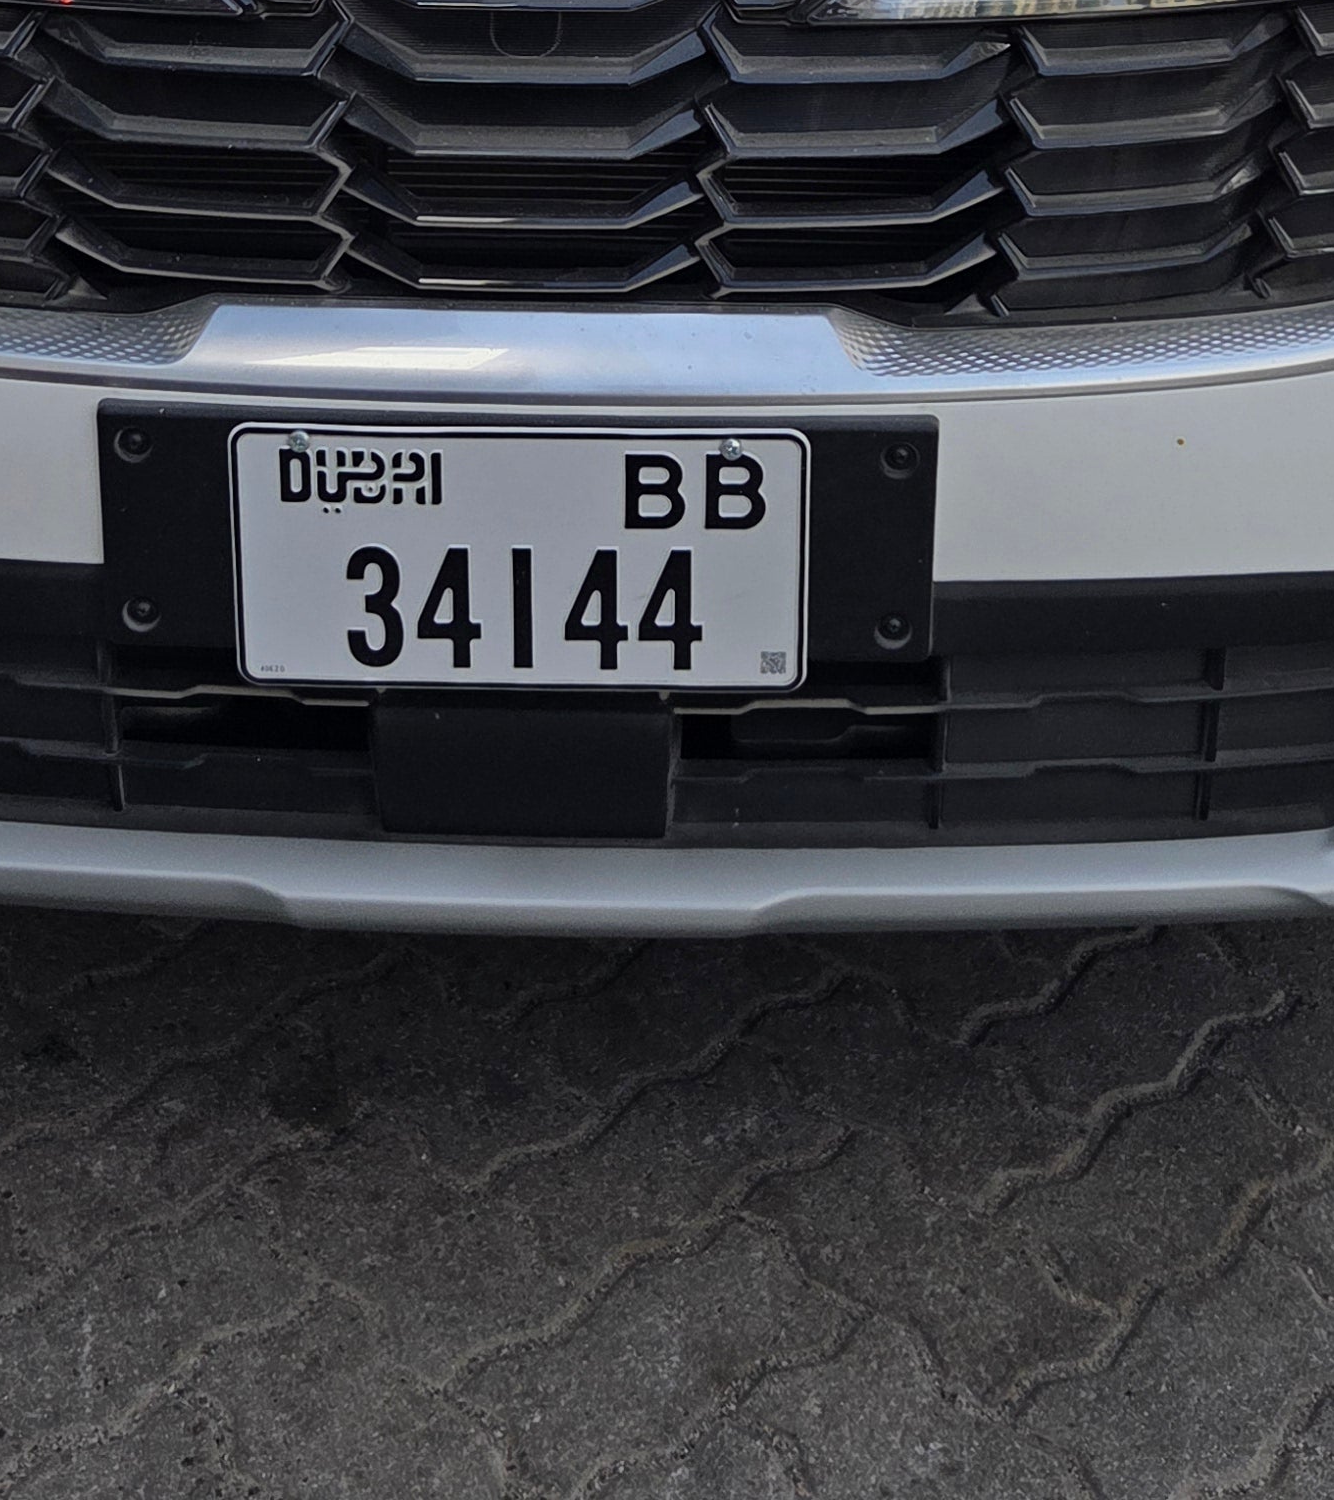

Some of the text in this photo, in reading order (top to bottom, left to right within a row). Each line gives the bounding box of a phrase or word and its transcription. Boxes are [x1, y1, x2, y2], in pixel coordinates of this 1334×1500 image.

[279, 448, 766, 530] DUBAI BB
[346, 546, 703, 670] 34144
